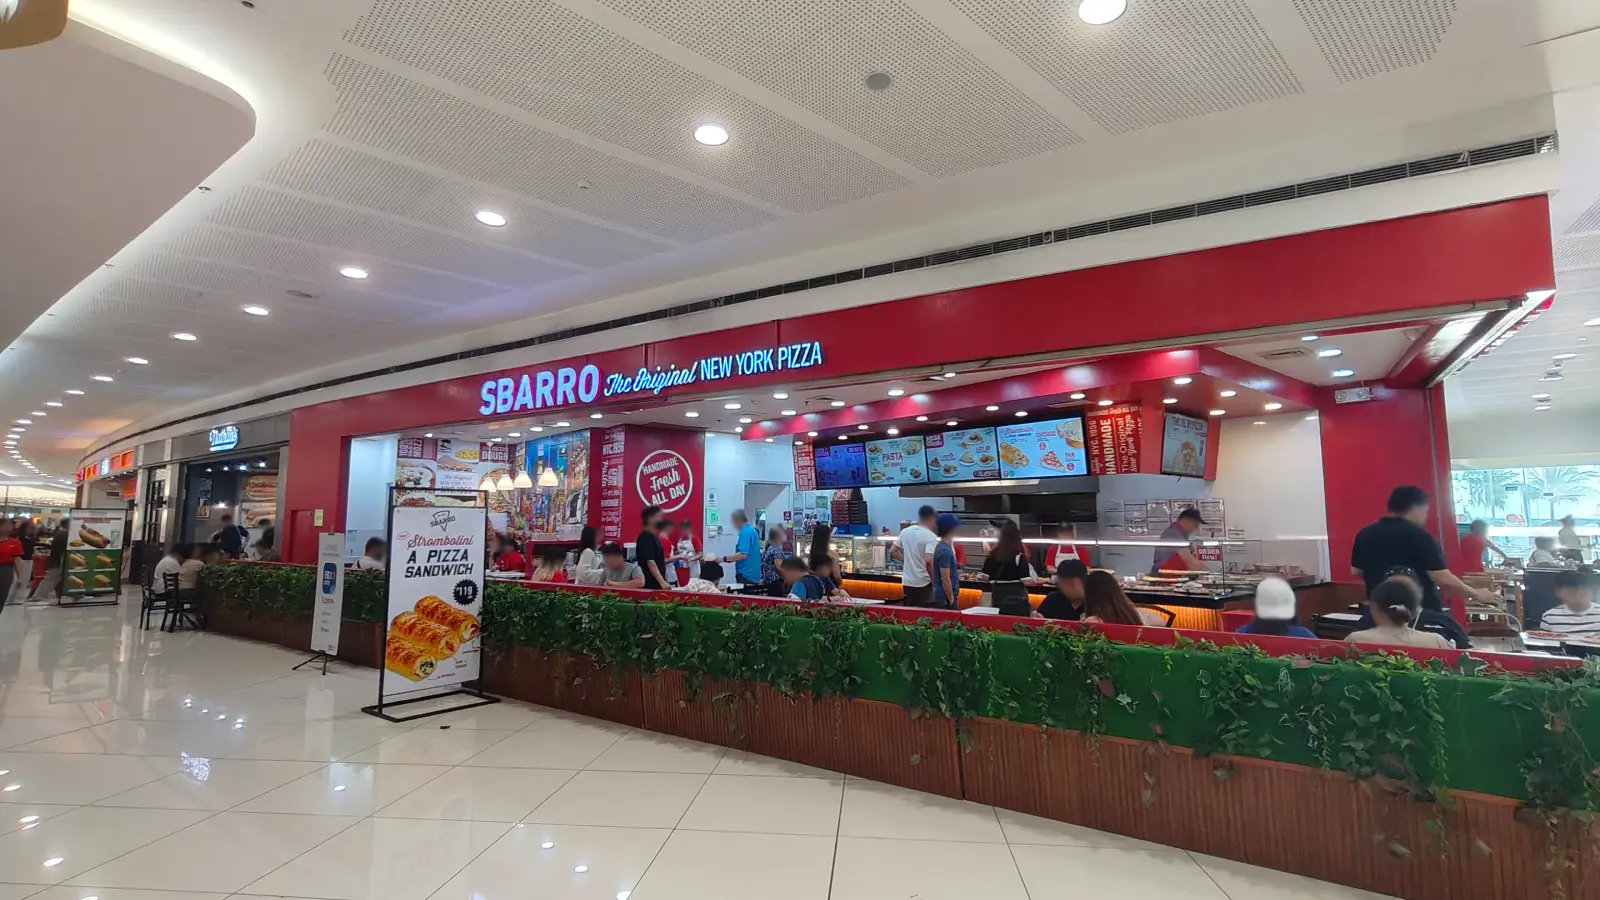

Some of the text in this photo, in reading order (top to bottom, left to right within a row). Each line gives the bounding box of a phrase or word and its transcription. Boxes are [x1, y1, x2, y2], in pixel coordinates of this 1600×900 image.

[603, 341, 823, 396] The Original NEW YORK PIZZA
[479, 364, 600, 416] SBARRO
[1116, 417, 1128, 454] Original
[482, 450, 509, 460] DOUGH
[1100, 418, 1117, 475] HANDMADE
[642, 456, 679, 475] HANDMADE
[882, 452, 904, 462] PASTA
[650, 468, 681, 491] Fresh
[652, 484, 686, 505] ALL DAY
[430, 515, 456, 527] SBARRO
[407, 534, 474, 550] Strombolini
[406, 549, 469, 564] A PIZZA
[405, 564, 474, 578] SANDWICH
